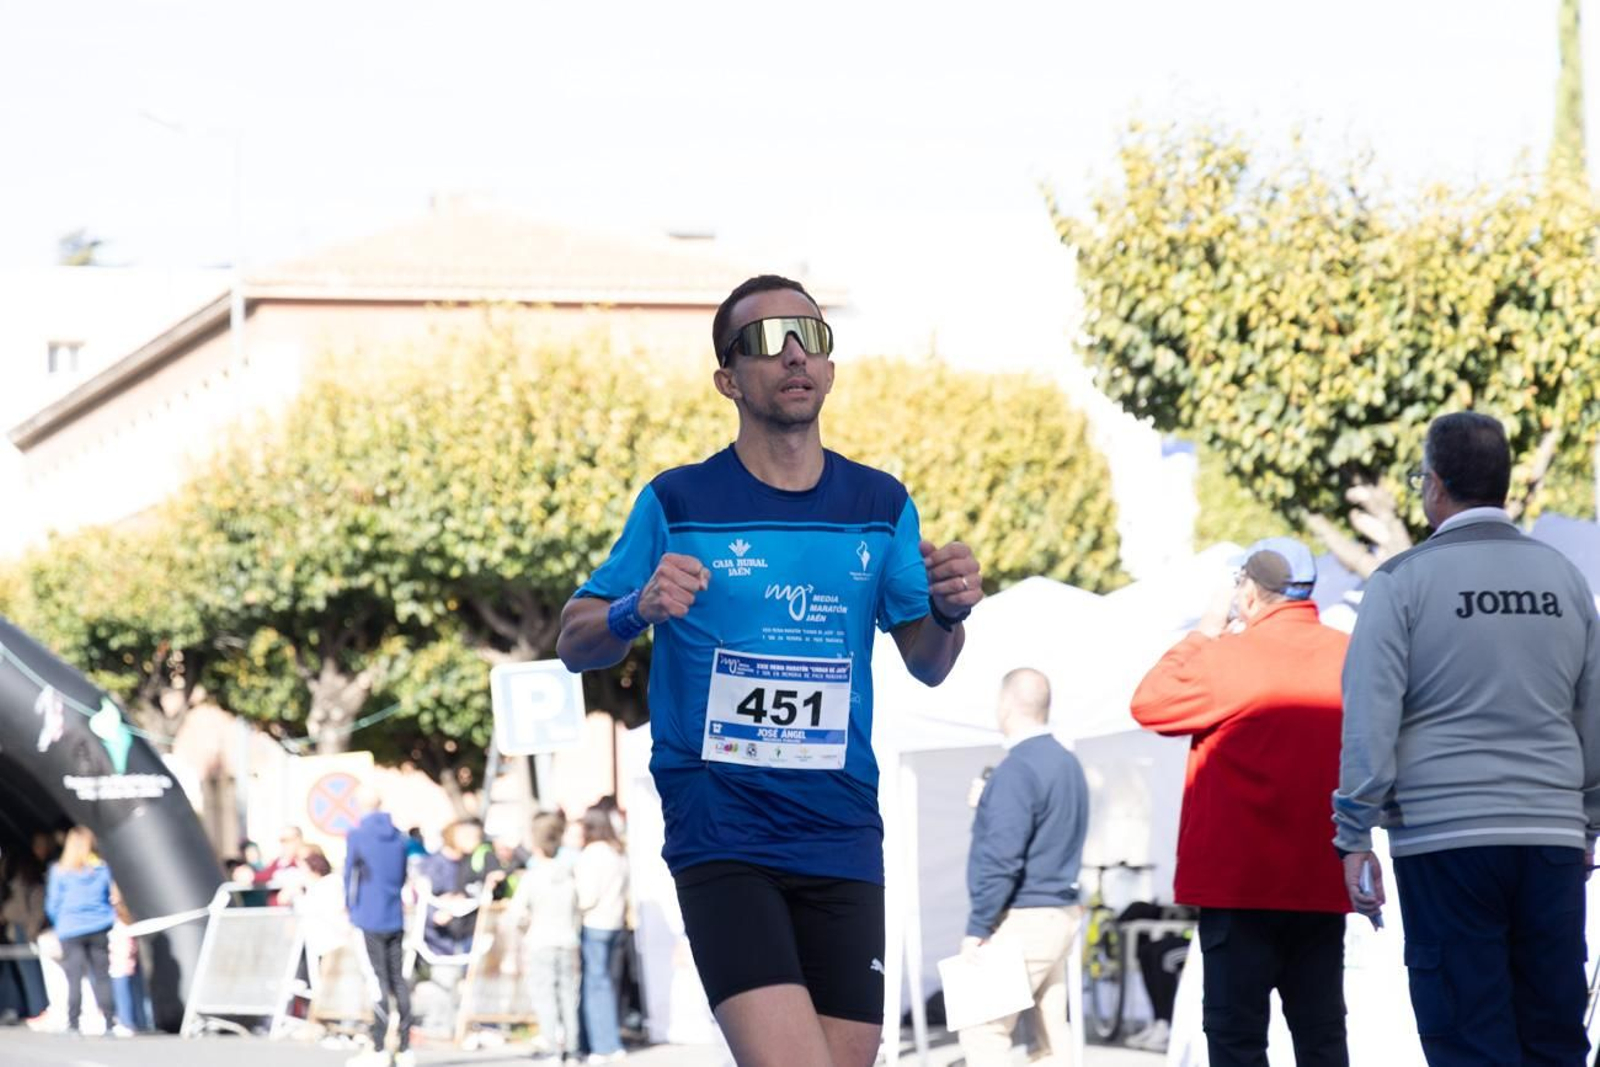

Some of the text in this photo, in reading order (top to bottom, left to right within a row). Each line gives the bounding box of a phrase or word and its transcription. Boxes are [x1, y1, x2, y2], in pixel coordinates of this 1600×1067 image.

[712, 558, 768, 569] CAJA RURAL
[728, 566, 751, 577] JAÉN
[812, 594, 839, 603] MEDIA
[809, 603, 848, 614] MARATÓN
[806, 613, 827, 622] JAÉN
[510, 673, 566, 744] P
[736, 687, 823, 727] 451
[757, 728, 807, 739] JOSÉ ÁNGEL
